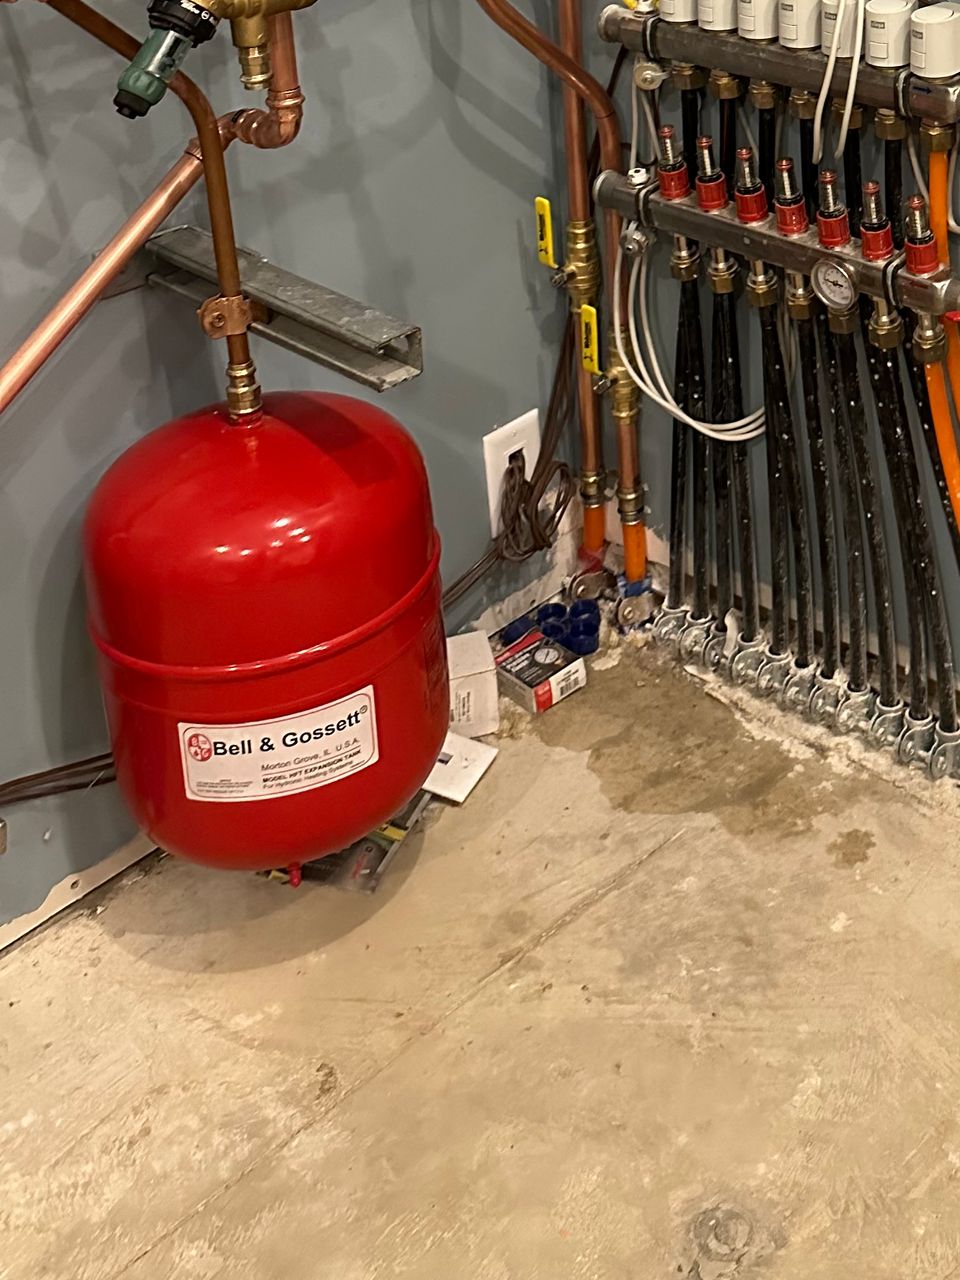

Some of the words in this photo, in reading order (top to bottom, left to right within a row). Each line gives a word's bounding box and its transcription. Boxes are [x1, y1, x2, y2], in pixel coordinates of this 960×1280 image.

[213, 739, 252, 756] Bell
[259, 737, 275, 752] &
[282, 711, 361, 748] Gossett
[261, 760, 291, 771] Morton
[293, 753, 321, 765] Grove,
[304, 758, 344, 775] EXPANSION
[344, 749, 361, 760] TANK
